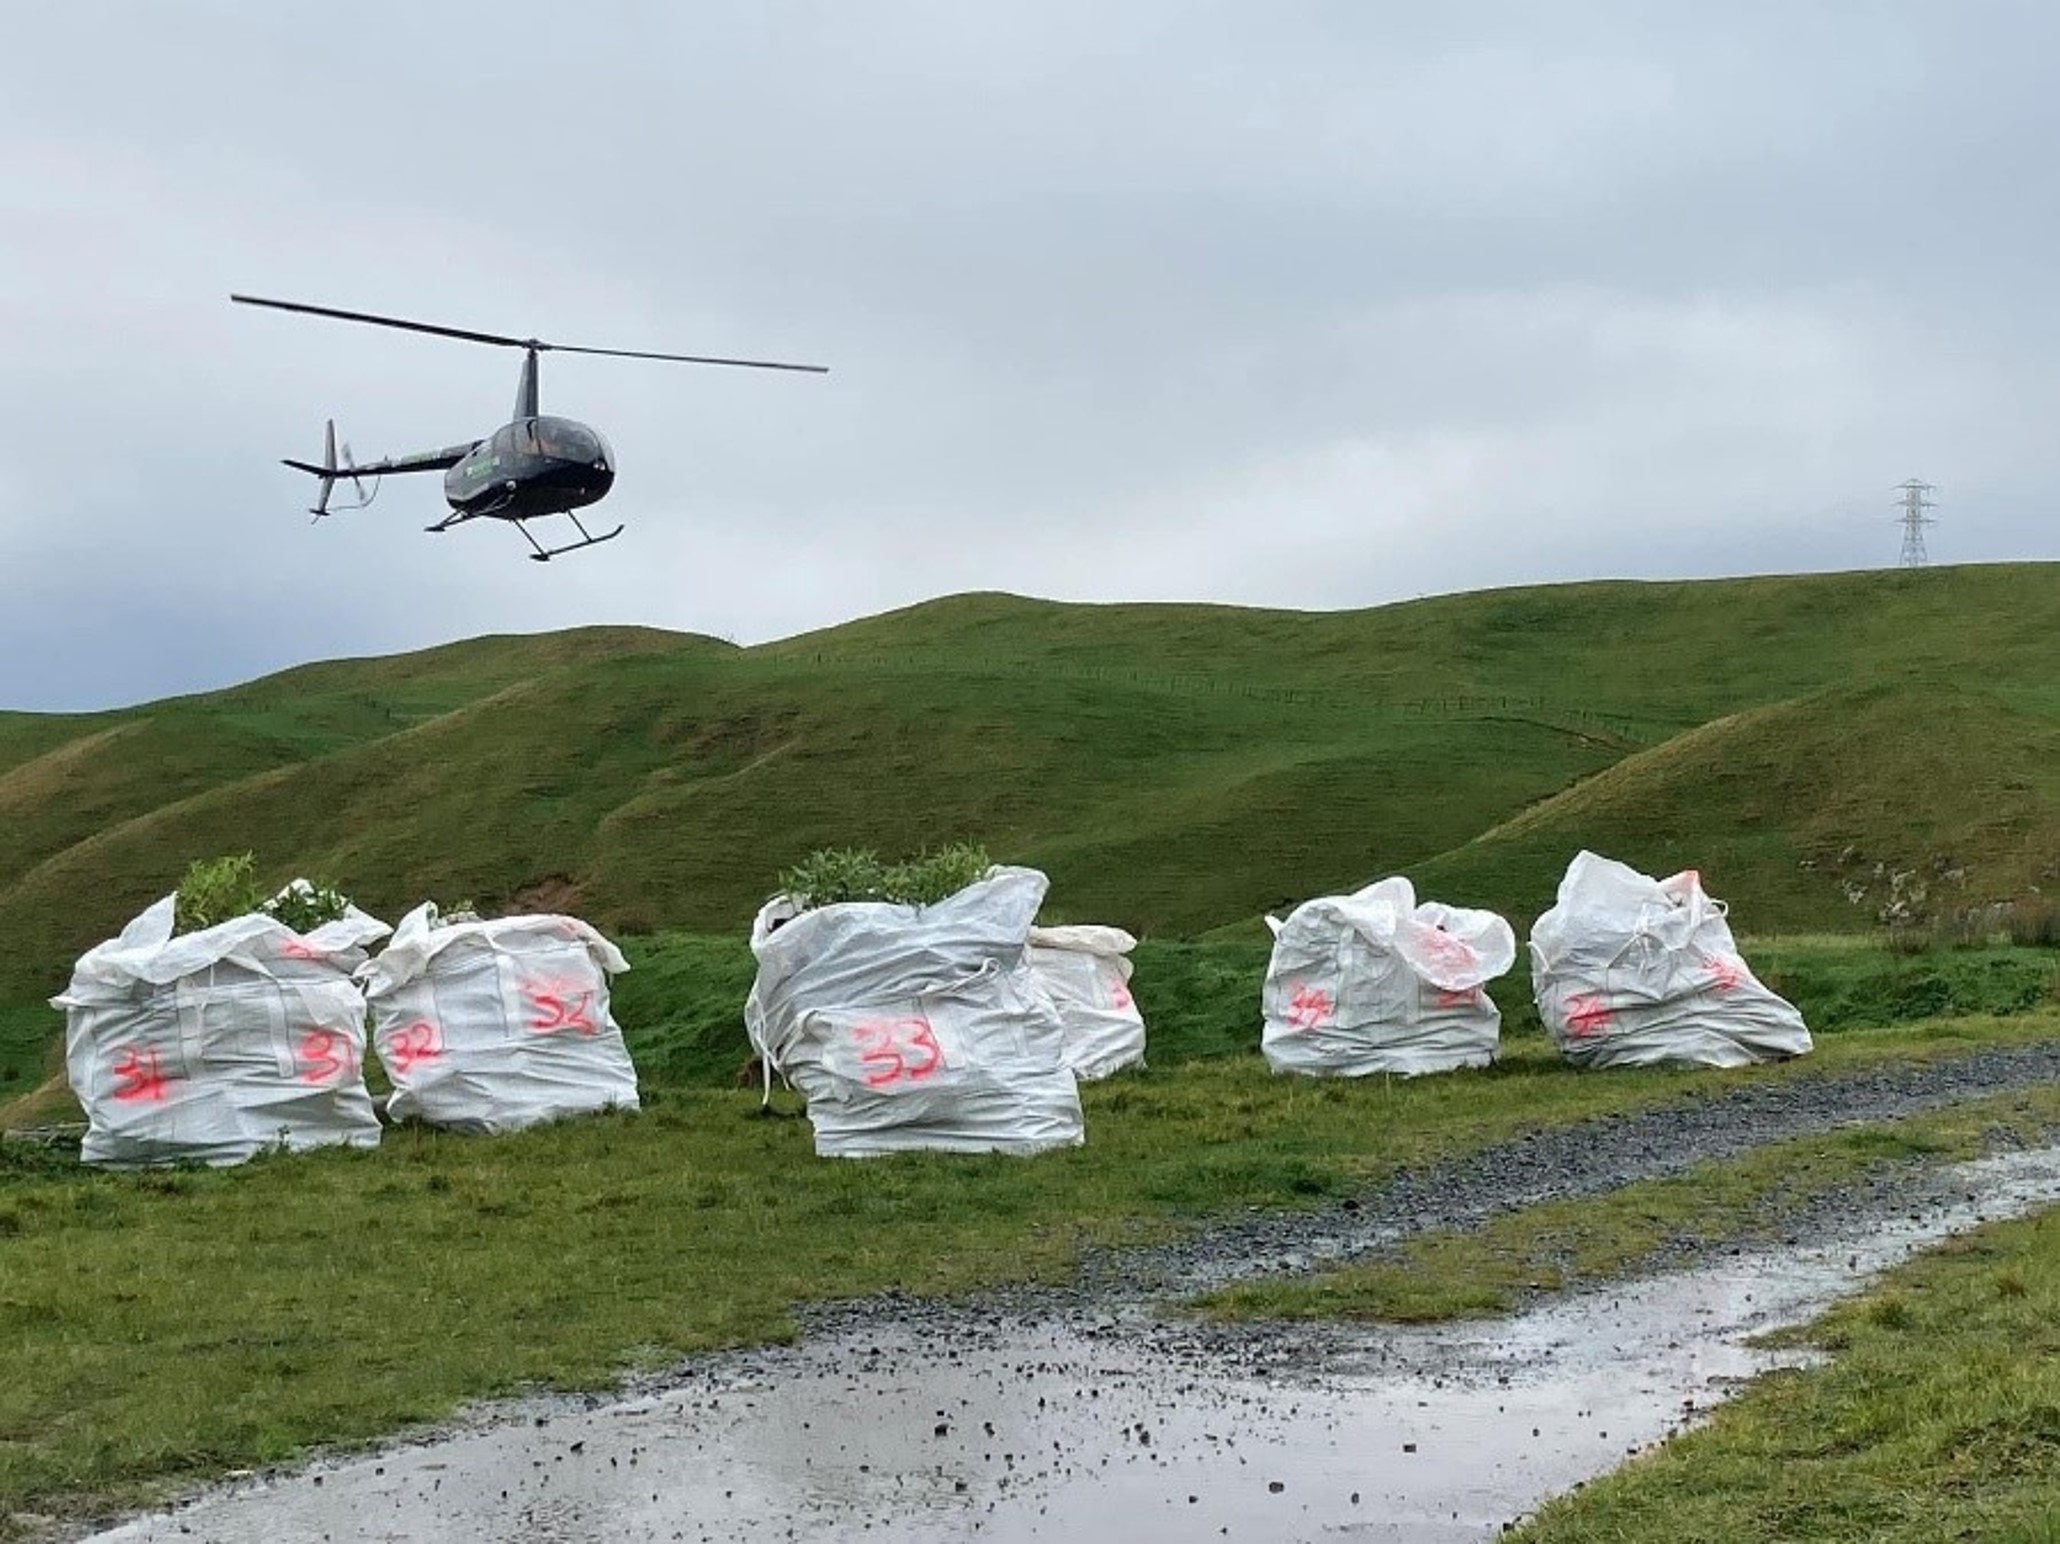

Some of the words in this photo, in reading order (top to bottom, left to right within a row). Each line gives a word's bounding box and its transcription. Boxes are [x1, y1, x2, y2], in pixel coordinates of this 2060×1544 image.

[301, 1029, 354, 1083] 31
[388, 1022, 440, 1074] 32
[853, 1016, 942, 1087] 33
